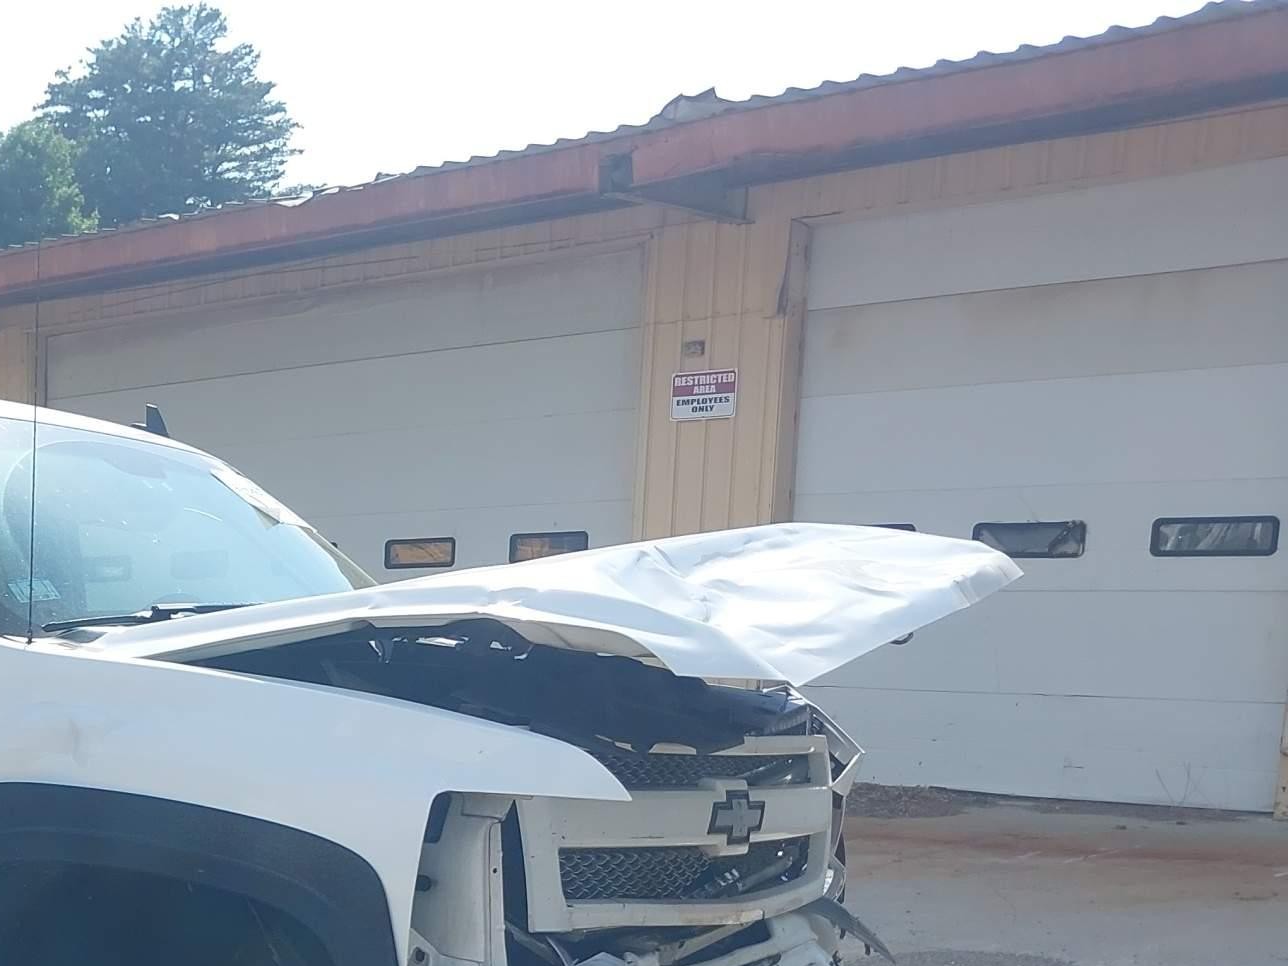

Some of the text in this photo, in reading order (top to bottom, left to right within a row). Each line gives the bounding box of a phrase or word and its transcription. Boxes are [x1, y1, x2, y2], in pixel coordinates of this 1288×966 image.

[674, 373, 735, 387] RESTRICTED
[693, 385, 716, 394] AREA
[676, 396, 730, 406] EMPLOYEES
[691, 405, 715, 413] ONLY
